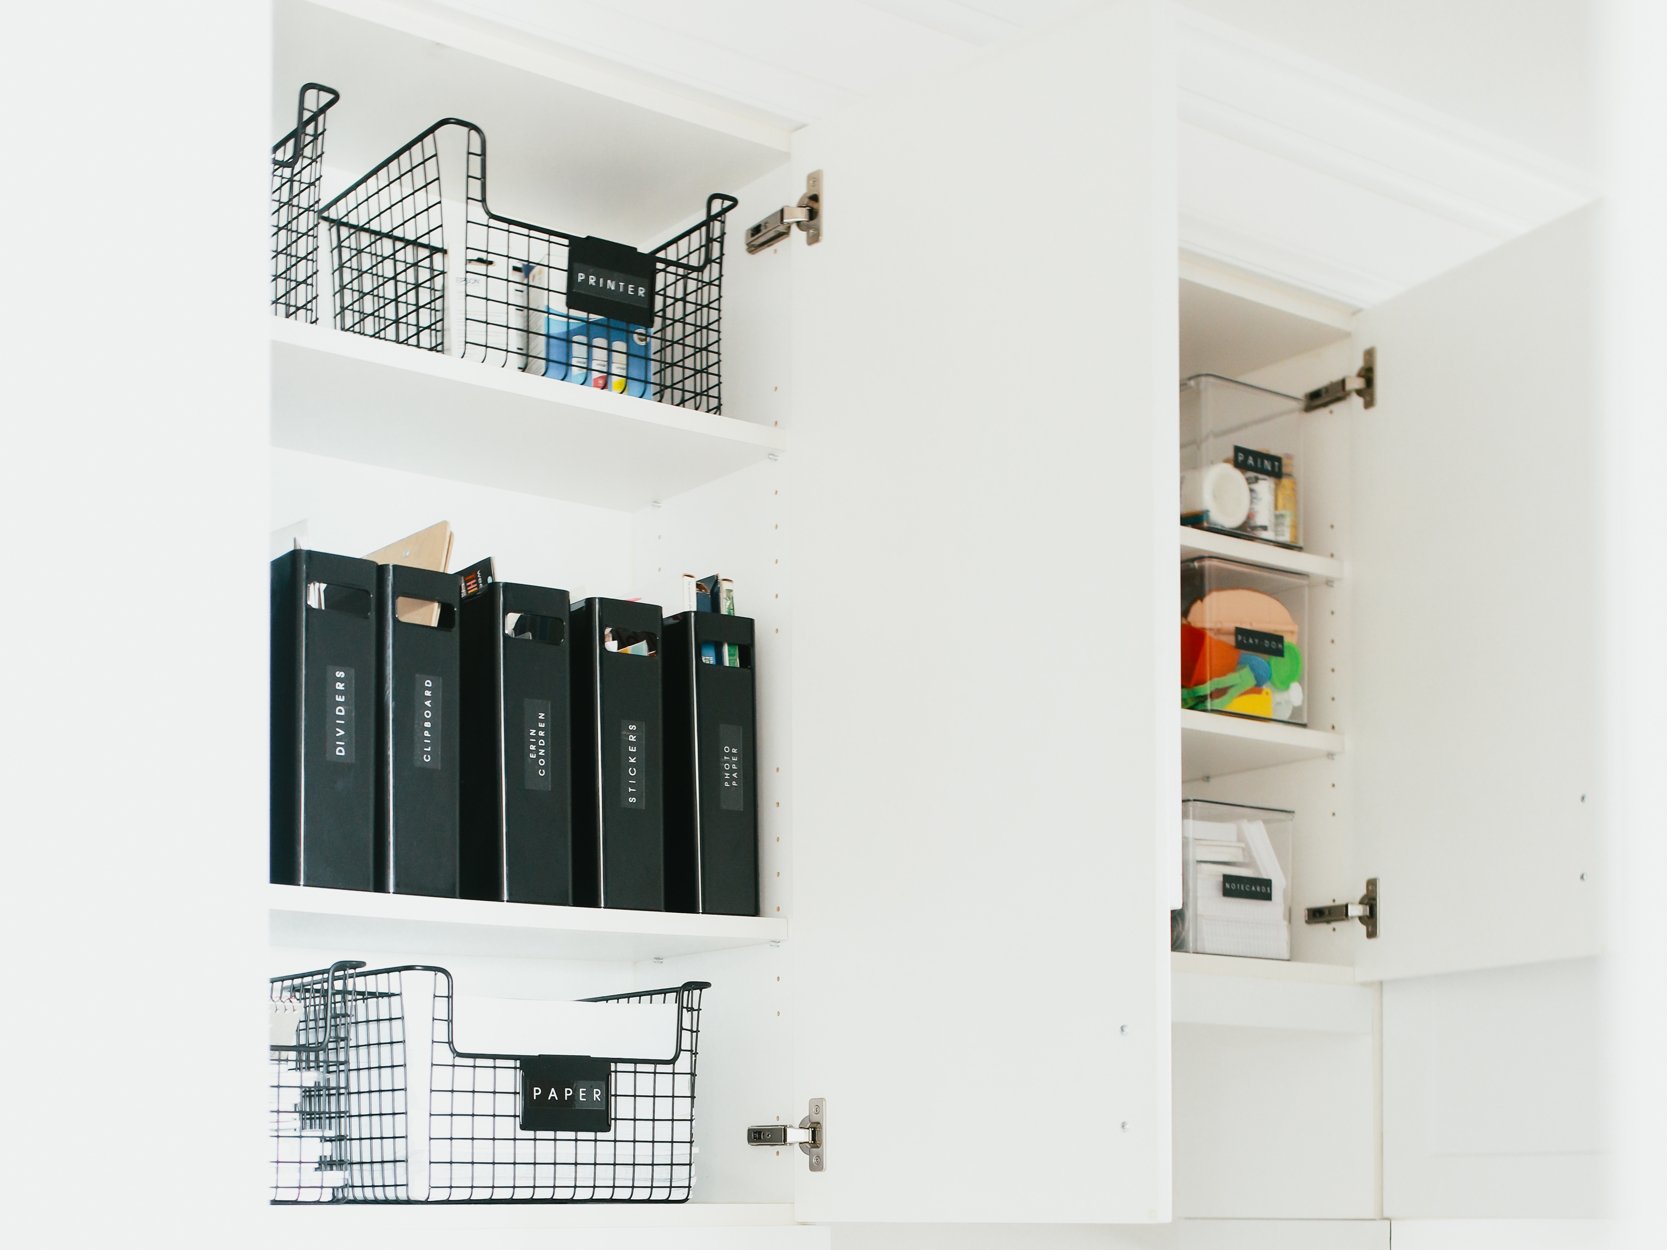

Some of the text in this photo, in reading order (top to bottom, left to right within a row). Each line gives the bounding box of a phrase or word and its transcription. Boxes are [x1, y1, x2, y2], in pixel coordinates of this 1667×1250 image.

[577, 272, 646, 297] PRINTER
[1238, 453, 1280, 473] PAINT
[335, 670, 345, 756] DIVIDERS
[423, 679, 432, 762] CLIPBOARD
[628, 724, 637, 803] STICKERS
[533, 1086, 602, 1101] PAPER
